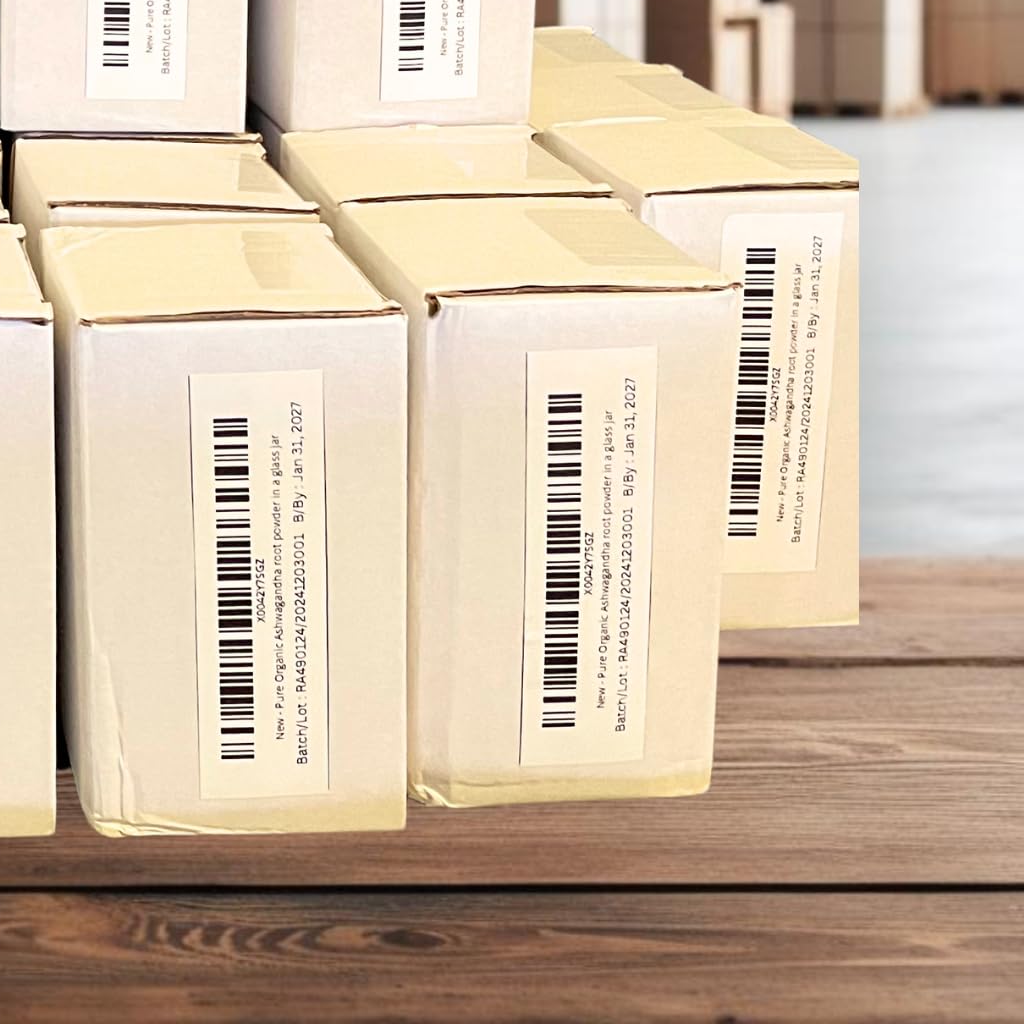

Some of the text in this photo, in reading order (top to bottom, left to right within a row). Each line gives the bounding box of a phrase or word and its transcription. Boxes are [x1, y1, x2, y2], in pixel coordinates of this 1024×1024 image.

[454, 26, 465, 75] Batch/Lot
[811, 236, 824, 263] 2027
[810, 266, 823, 282] 31,
[810, 284, 820, 304] Jan
[806, 313, 821, 339] B/By
[624, 377, 637, 409] 2027
[290, 401, 303, 433] 2027
[624, 412, 638, 430] 31,
[796, 348, 816, 482] RA490124/20241203001
[291, 436, 304, 455] 31,
[624, 434, 635, 457] Jan
[292, 458, 303, 482] Jan
[622, 467, 638, 497] B/By
[292, 492, 307, 523] B/By
[791, 491, 805, 543] Batch/Lot
[618, 507, 634, 662] RA490124/20241203001
[293, 534, 307, 692] RA490124/20241203001
[615, 672, 629, 732] Batch/Lot
[296, 703, 308, 765] Batch/Lot
